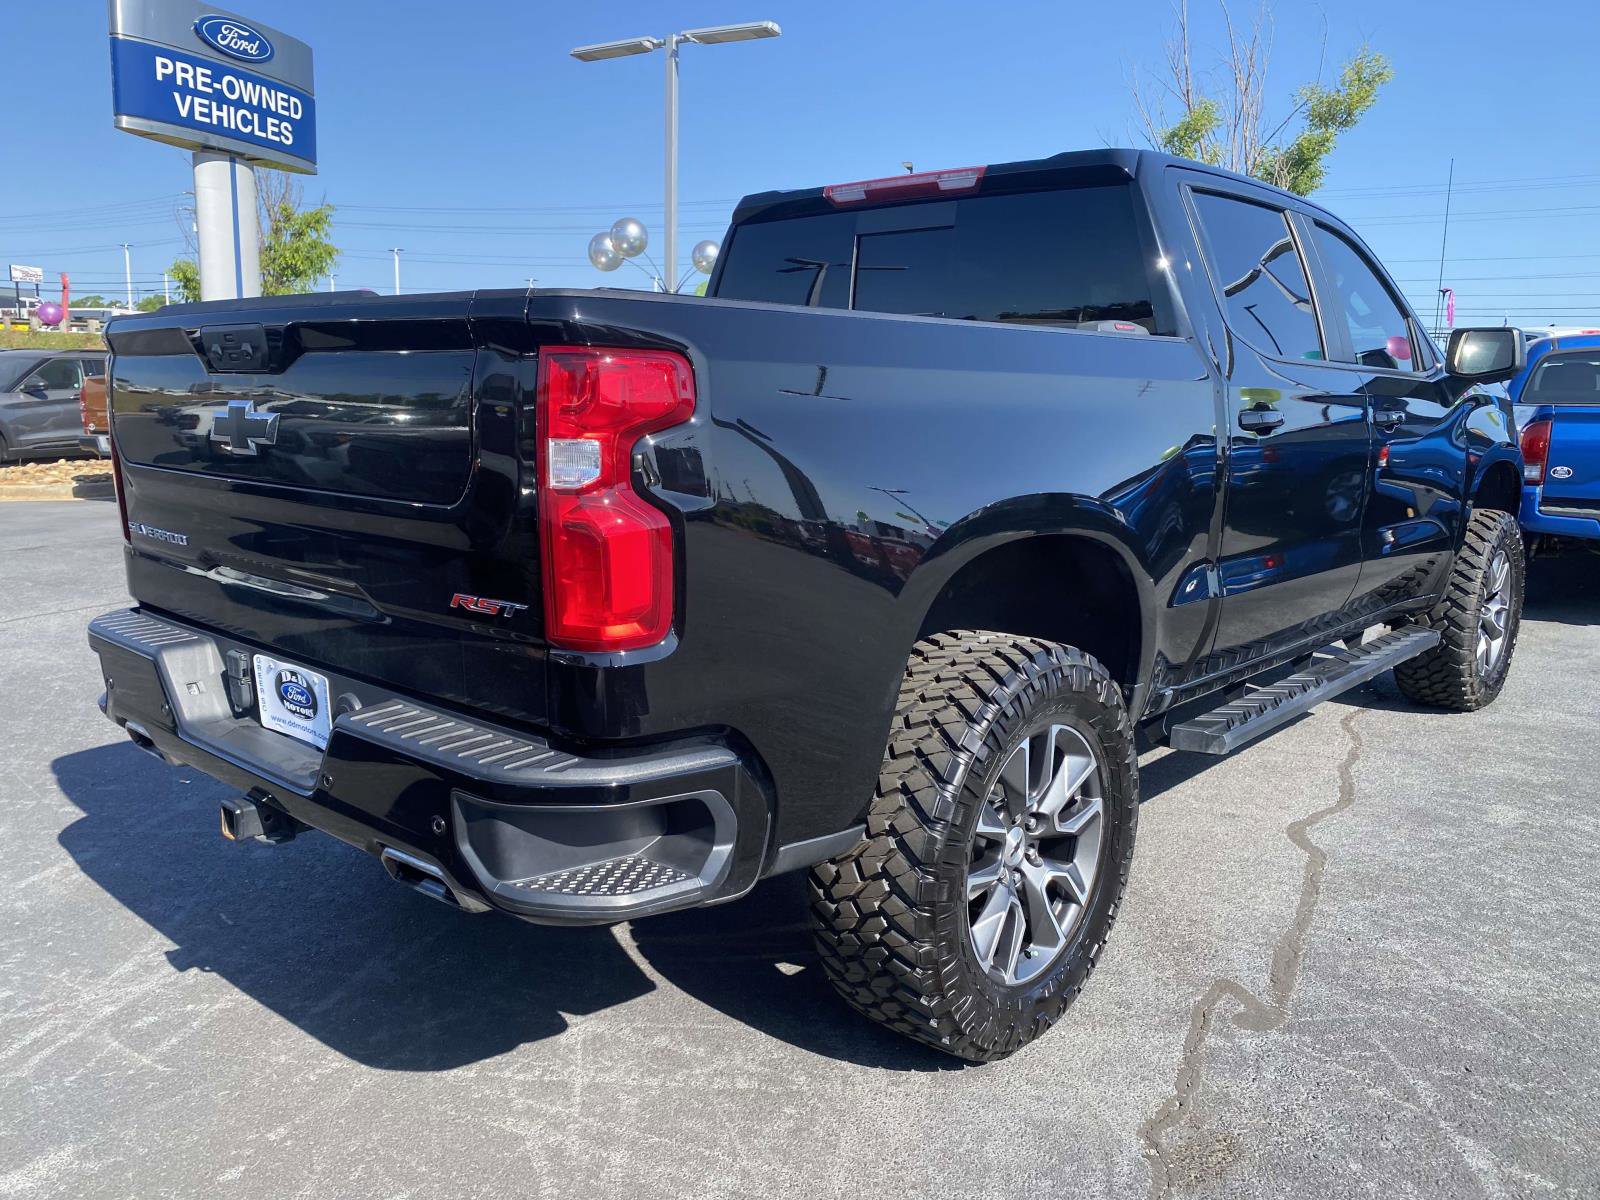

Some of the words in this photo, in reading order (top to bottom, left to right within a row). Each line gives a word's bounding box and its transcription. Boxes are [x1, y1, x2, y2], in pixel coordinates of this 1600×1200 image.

[217, 24, 260, 55] Ford
[155, 56, 303, 120] PRE-OWNED
[173, 92, 294, 145] VEHICLES
[450, 593, 528, 617] RST
[281, 671, 307, 687] D&D
[287, 686, 306, 703] Ford
